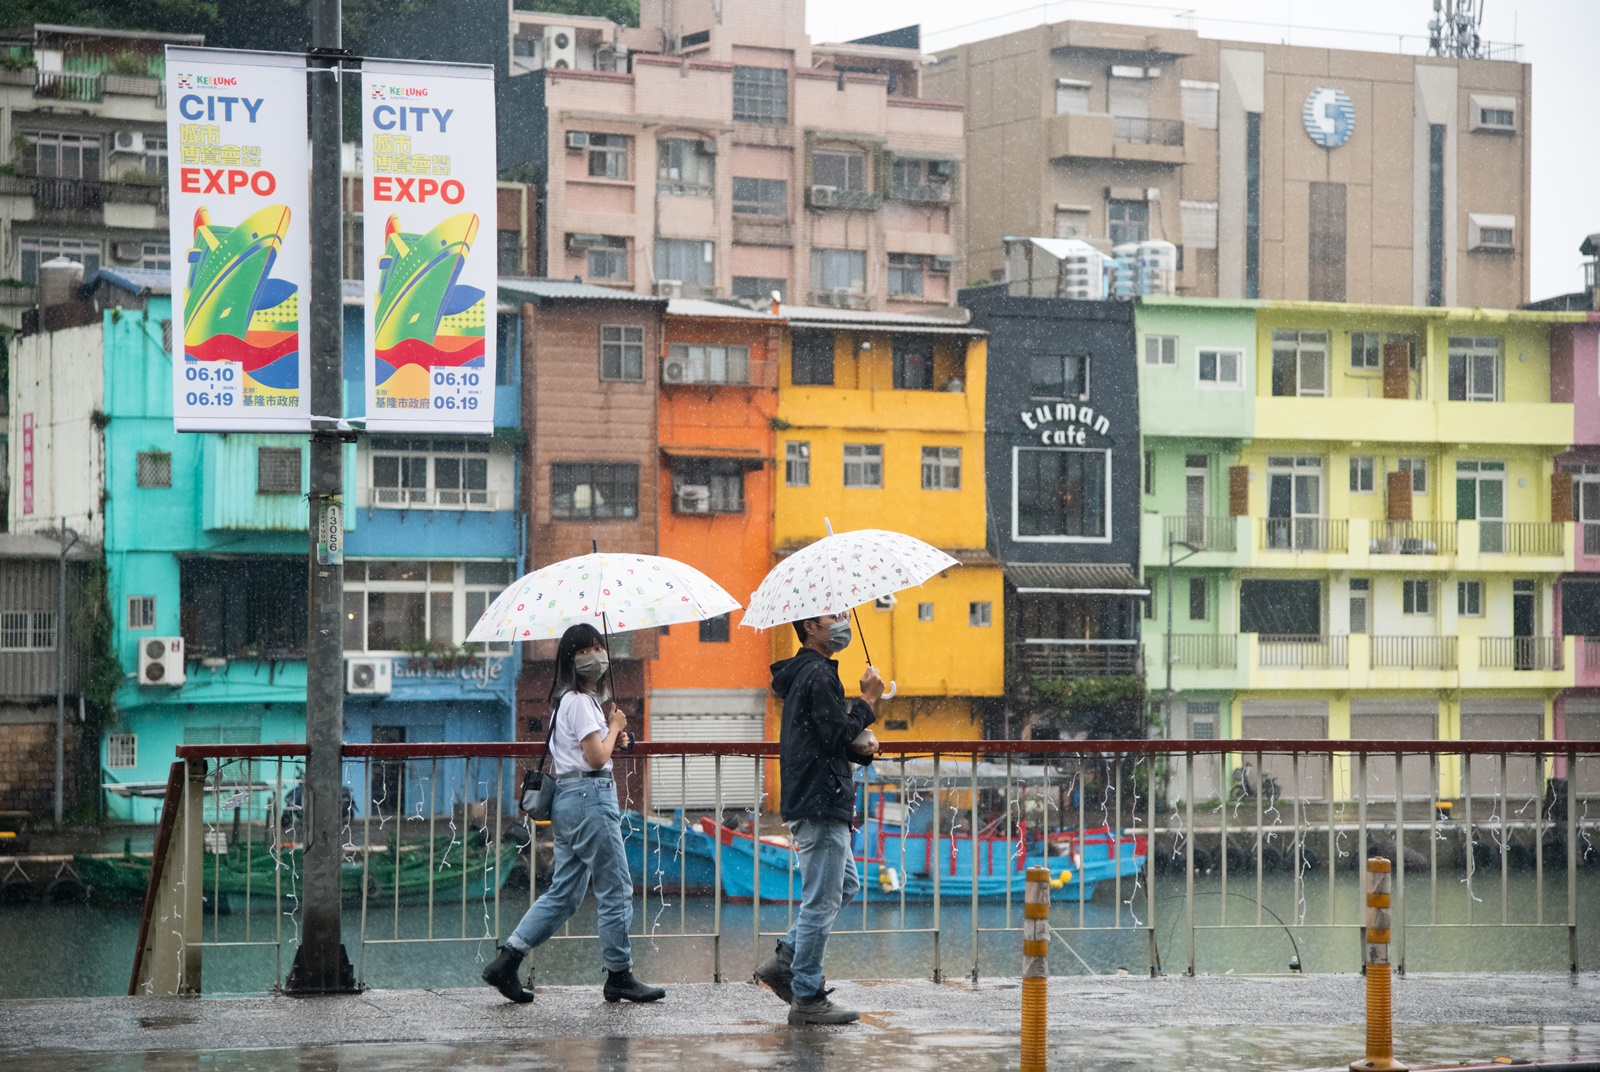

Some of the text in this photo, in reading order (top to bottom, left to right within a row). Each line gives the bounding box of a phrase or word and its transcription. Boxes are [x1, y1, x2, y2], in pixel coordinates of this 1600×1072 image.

[197, 75, 237, 86] KEELUNG
[390, 87, 428, 97] KEELUNG
[180, 94, 264, 123] CITY
[373, 105, 454, 133] CITY
[179, 124, 220, 145] 城市
[373, 133, 411, 155] 城市
[180, 144, 240, 167] 博覽會
[373, 153, 431, 175] 博覽會
[181, 168, 276, 197] EXPO
[373, 176, 465, 205] EXPO
[186, 367, 234, 381] 06.10
[434, 372, 480, 386] 06.10
[186, 392, 234, 406] 06.19
[243, 395, 299, 407] 基隆市政府
[376, 397, 430, 409] 基隆市政府
[434, 396, 479, 410] 06.19
[1020, 403, 1110, 435] tuman
[1041, 424, 1087, 446] café
[329, 508, 337, 552] 13056
